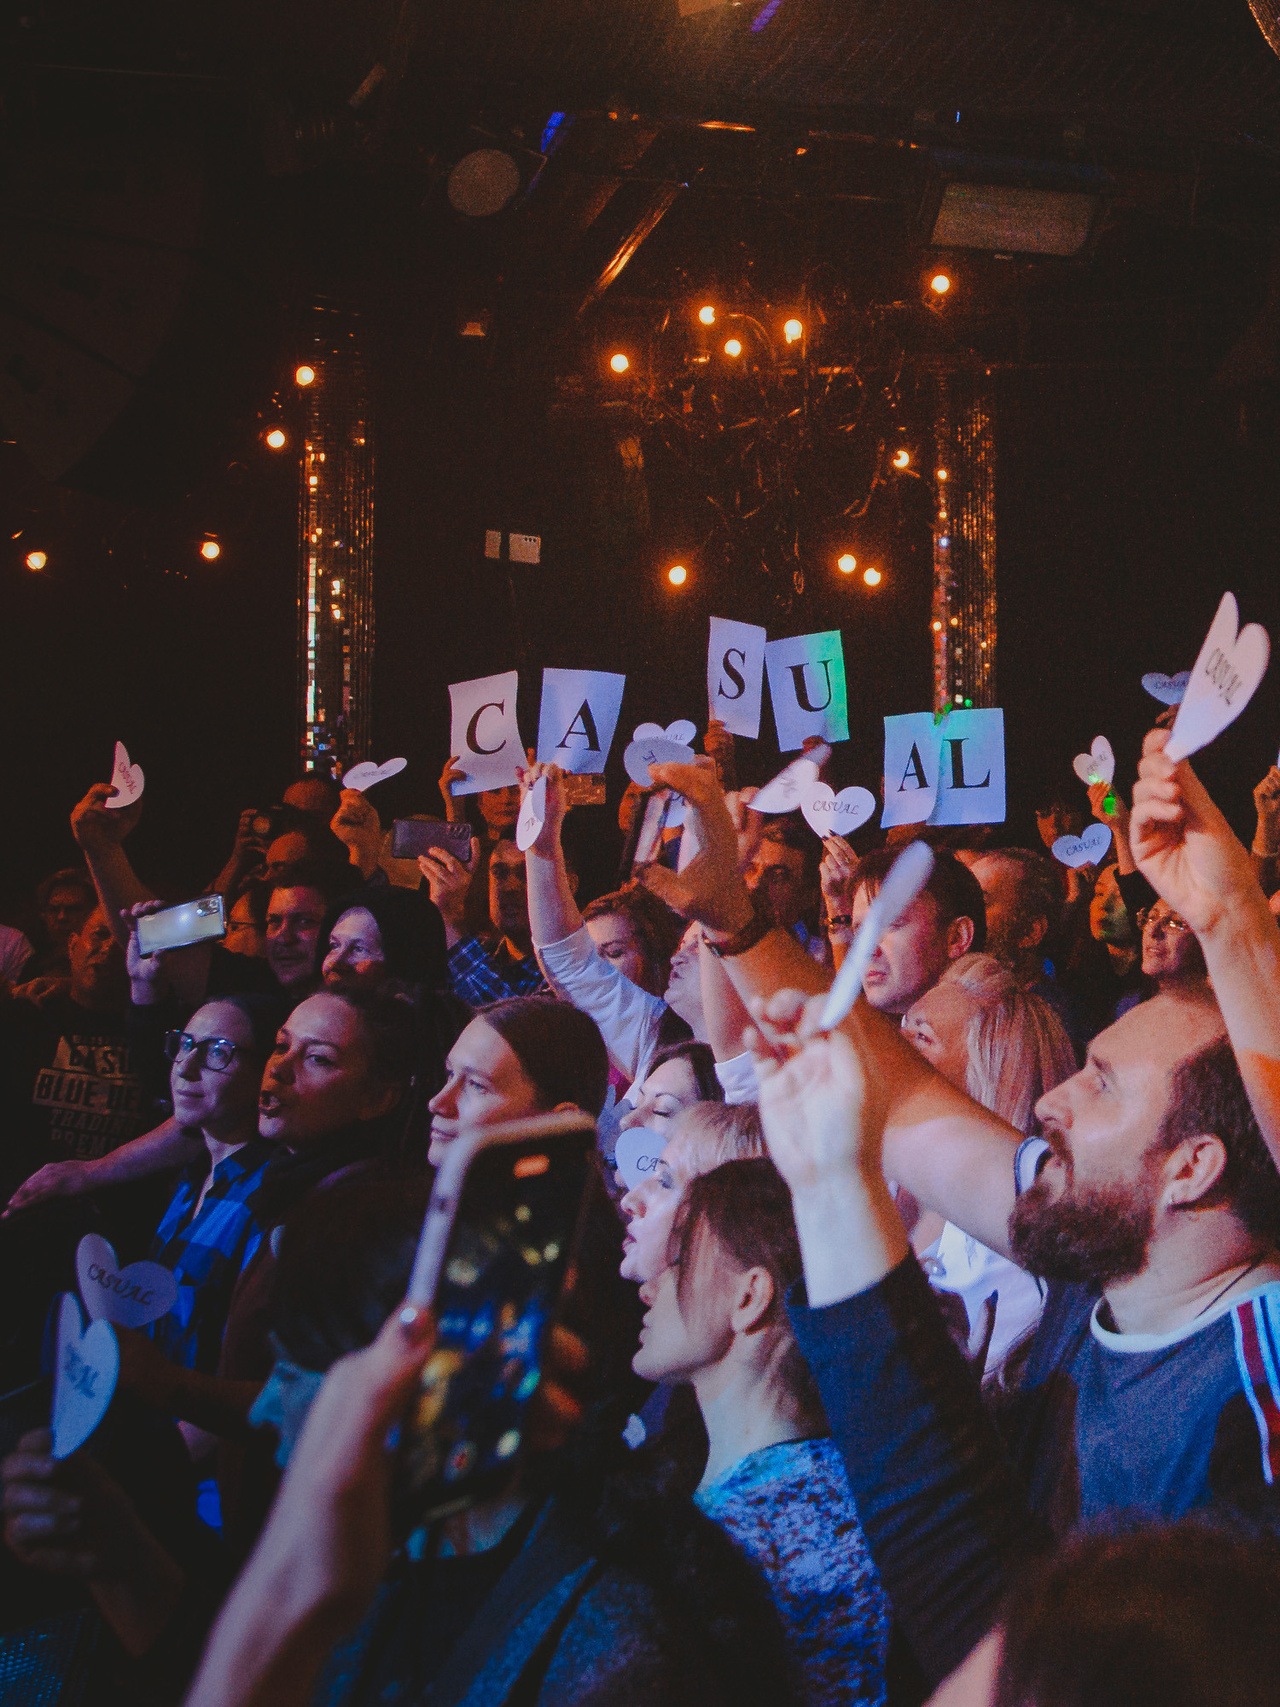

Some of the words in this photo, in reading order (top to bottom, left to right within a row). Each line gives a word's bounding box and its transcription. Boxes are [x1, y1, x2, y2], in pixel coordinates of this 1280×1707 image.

[812, 799, 859, 816] CASUAL
[36, 1073, 98, 1108] BLUE
[88, 1263, 155, 1305] CASUAL
